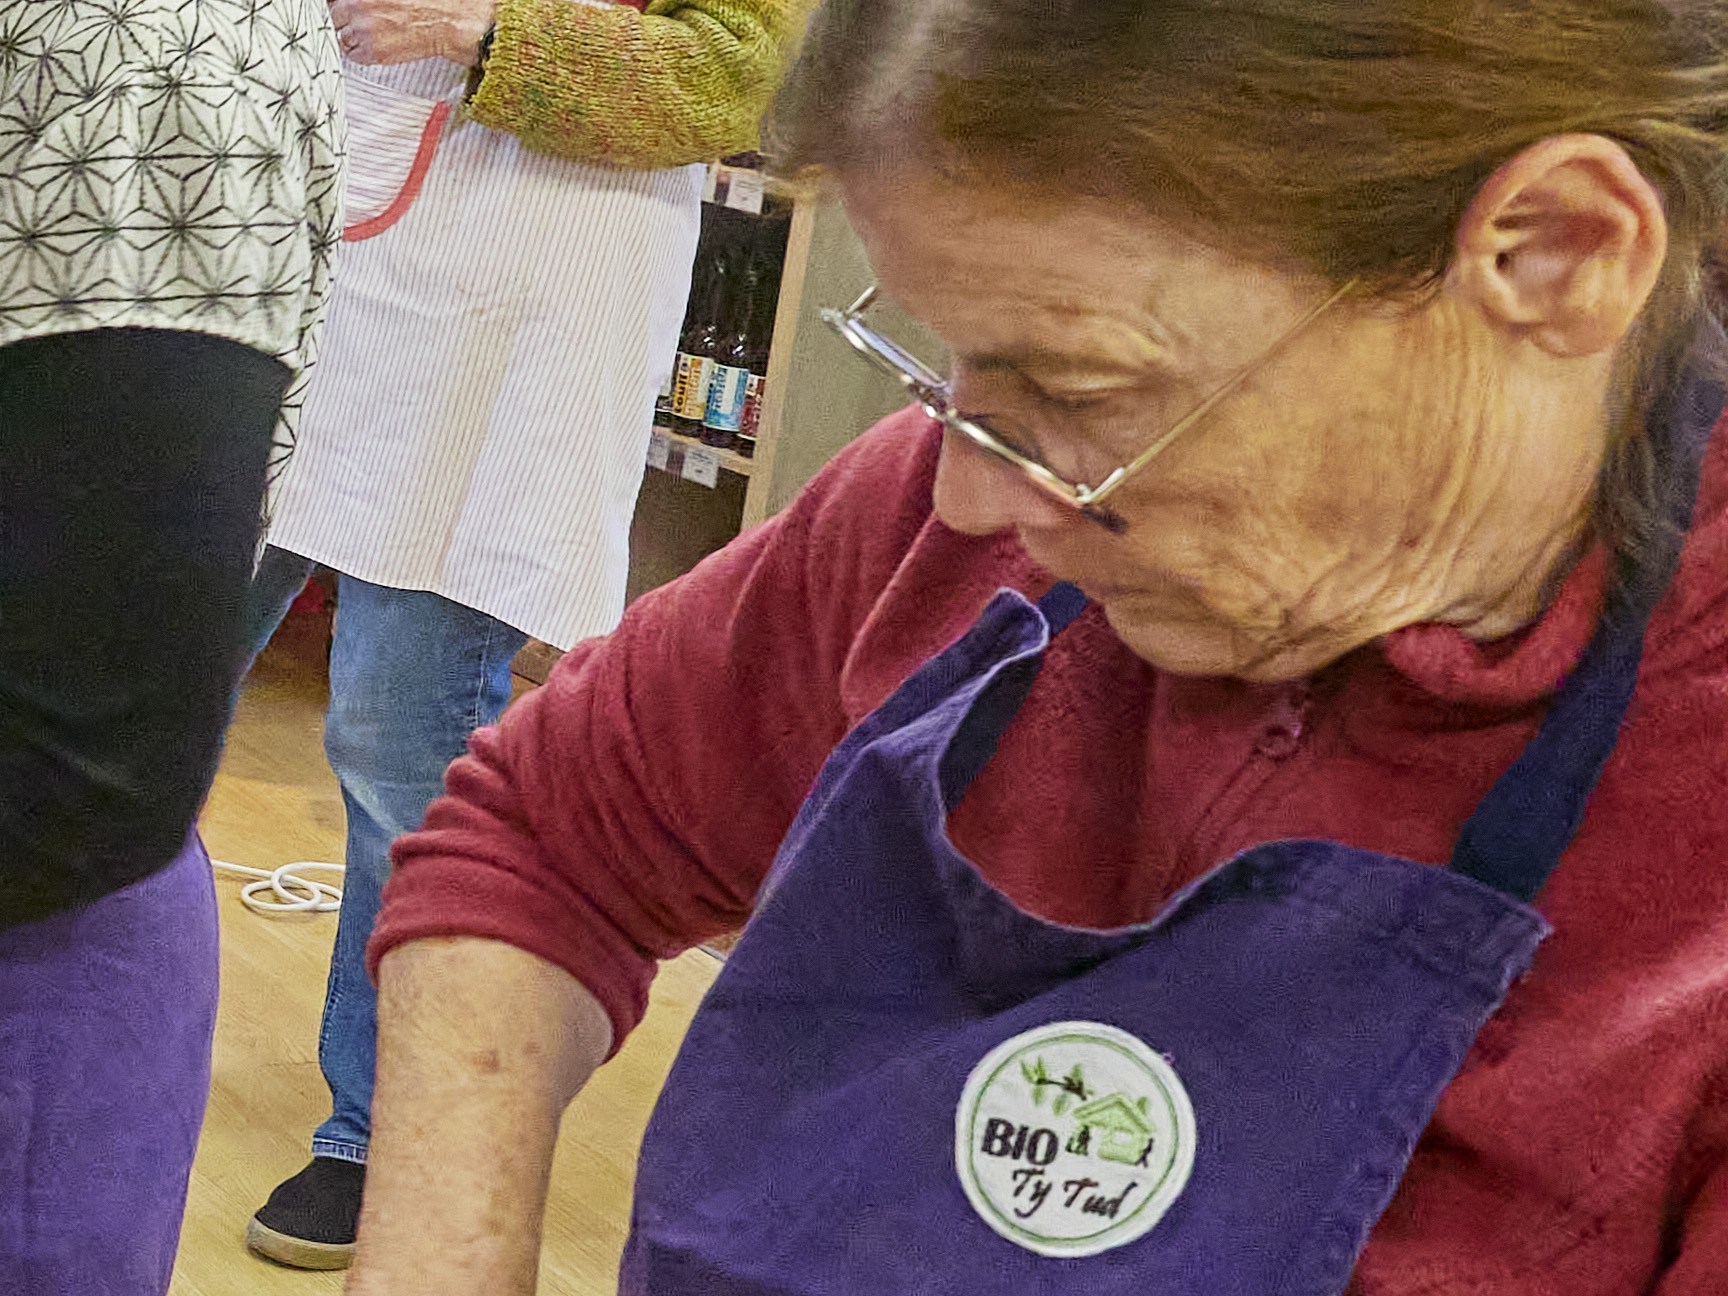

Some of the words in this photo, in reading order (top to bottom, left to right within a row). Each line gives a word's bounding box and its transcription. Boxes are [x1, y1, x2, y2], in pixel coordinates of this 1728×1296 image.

[980, 1117, 1059, 1167] BIO
[1012, 1169, 1053, 1218] Ty
[1064, 1177, 1138, 1220] Tud
